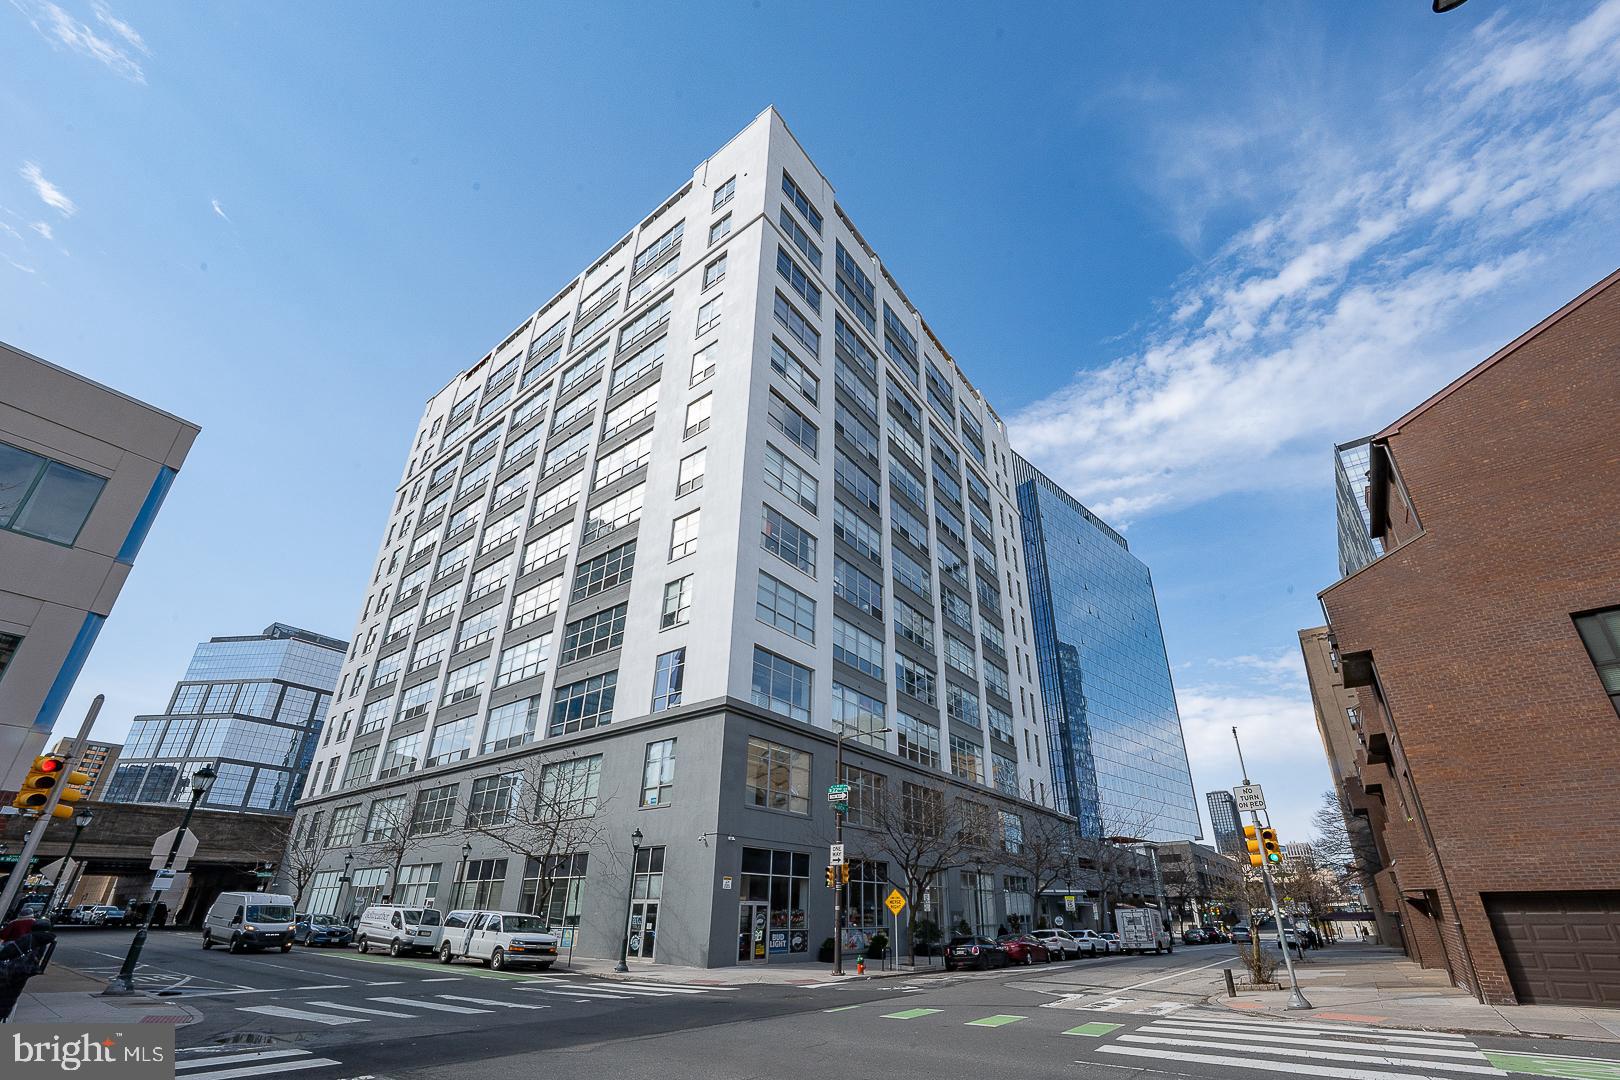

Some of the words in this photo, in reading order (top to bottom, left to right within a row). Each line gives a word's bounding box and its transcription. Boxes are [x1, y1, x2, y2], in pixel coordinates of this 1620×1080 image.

[1250, 800, 1264, 808] RED
[771, 933, 785, 941] BUD
[769, 940, 787, 948] LIGHT
